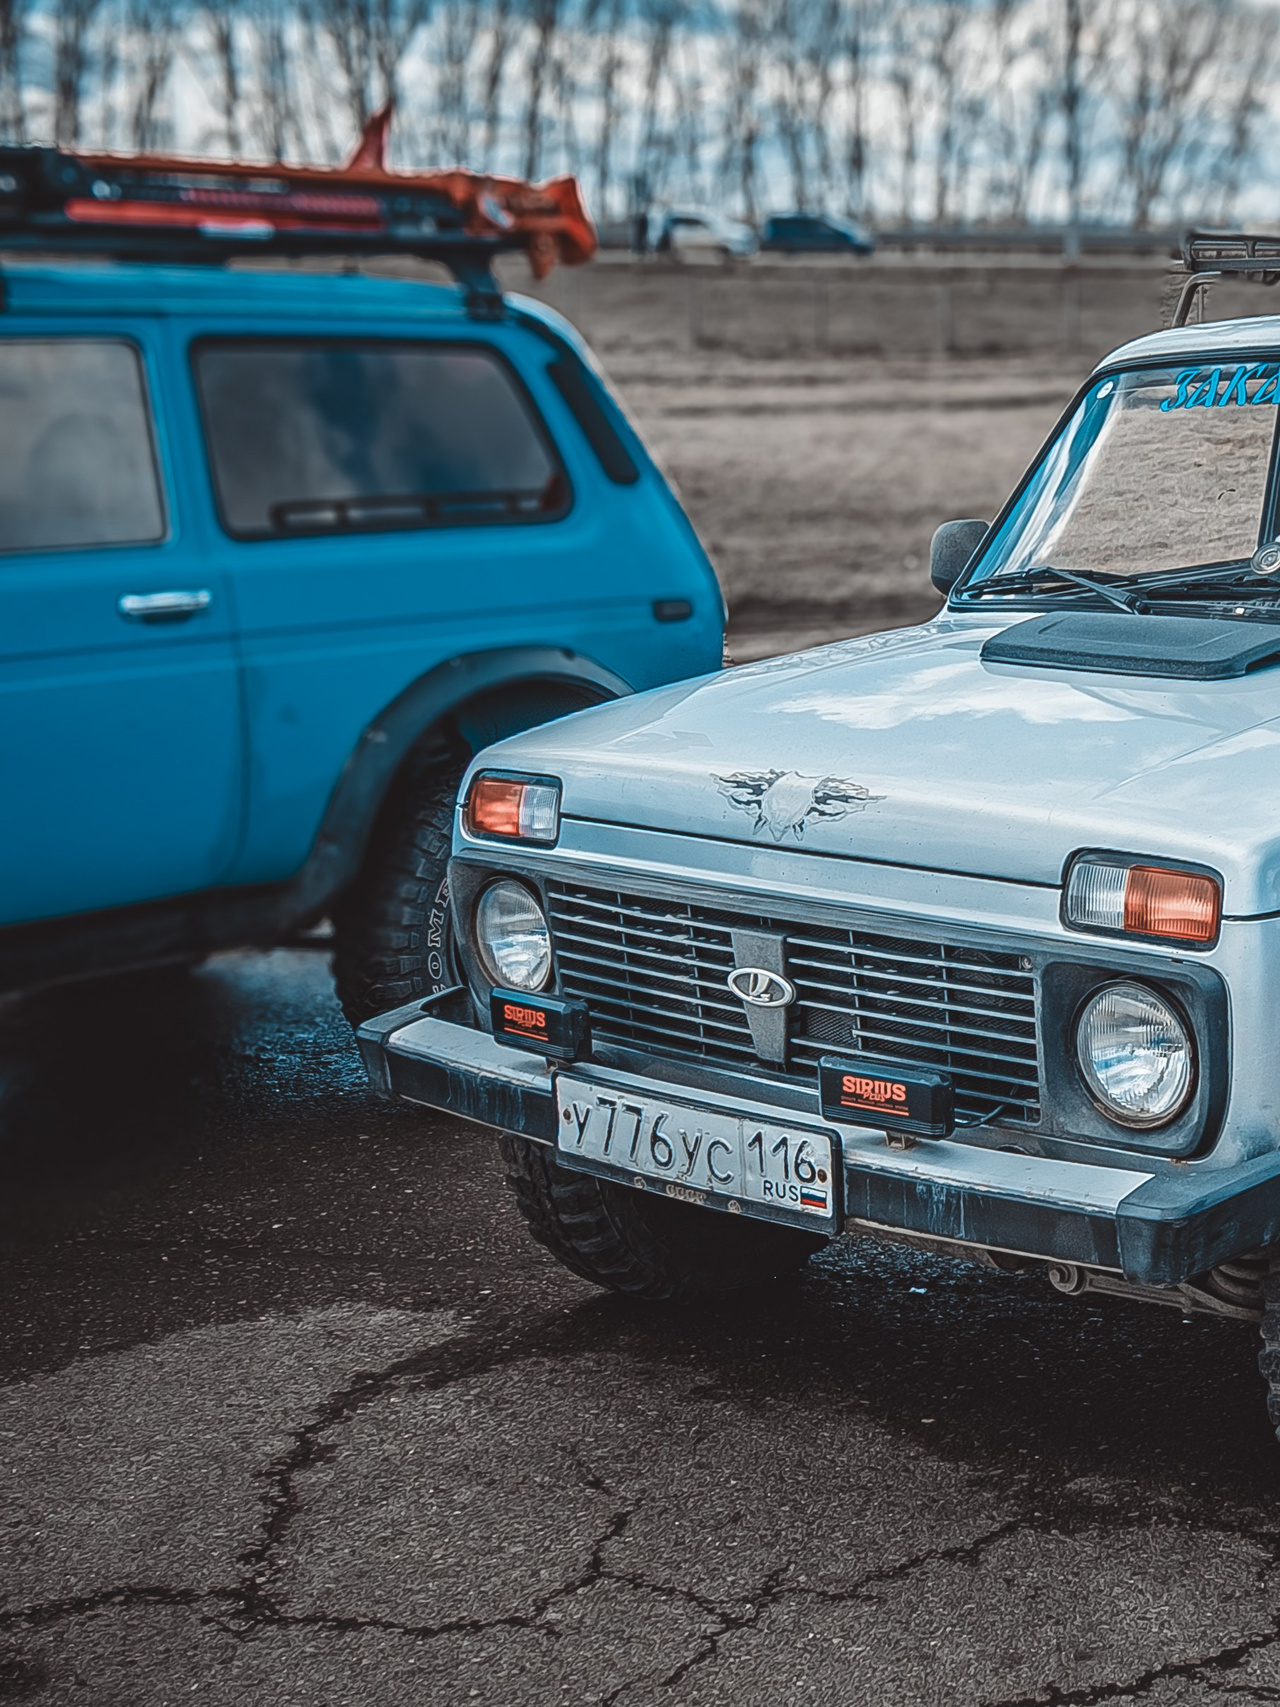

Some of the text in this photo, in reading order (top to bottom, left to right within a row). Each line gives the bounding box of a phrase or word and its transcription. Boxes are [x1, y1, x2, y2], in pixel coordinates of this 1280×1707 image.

[504, 1004, 546, 1028] SIRIUS
[842, 1075, 907, 1102] SIRIUS
[747, 1130, 818, 1185] 116
[763, 1179, 799, 1202] RUS
